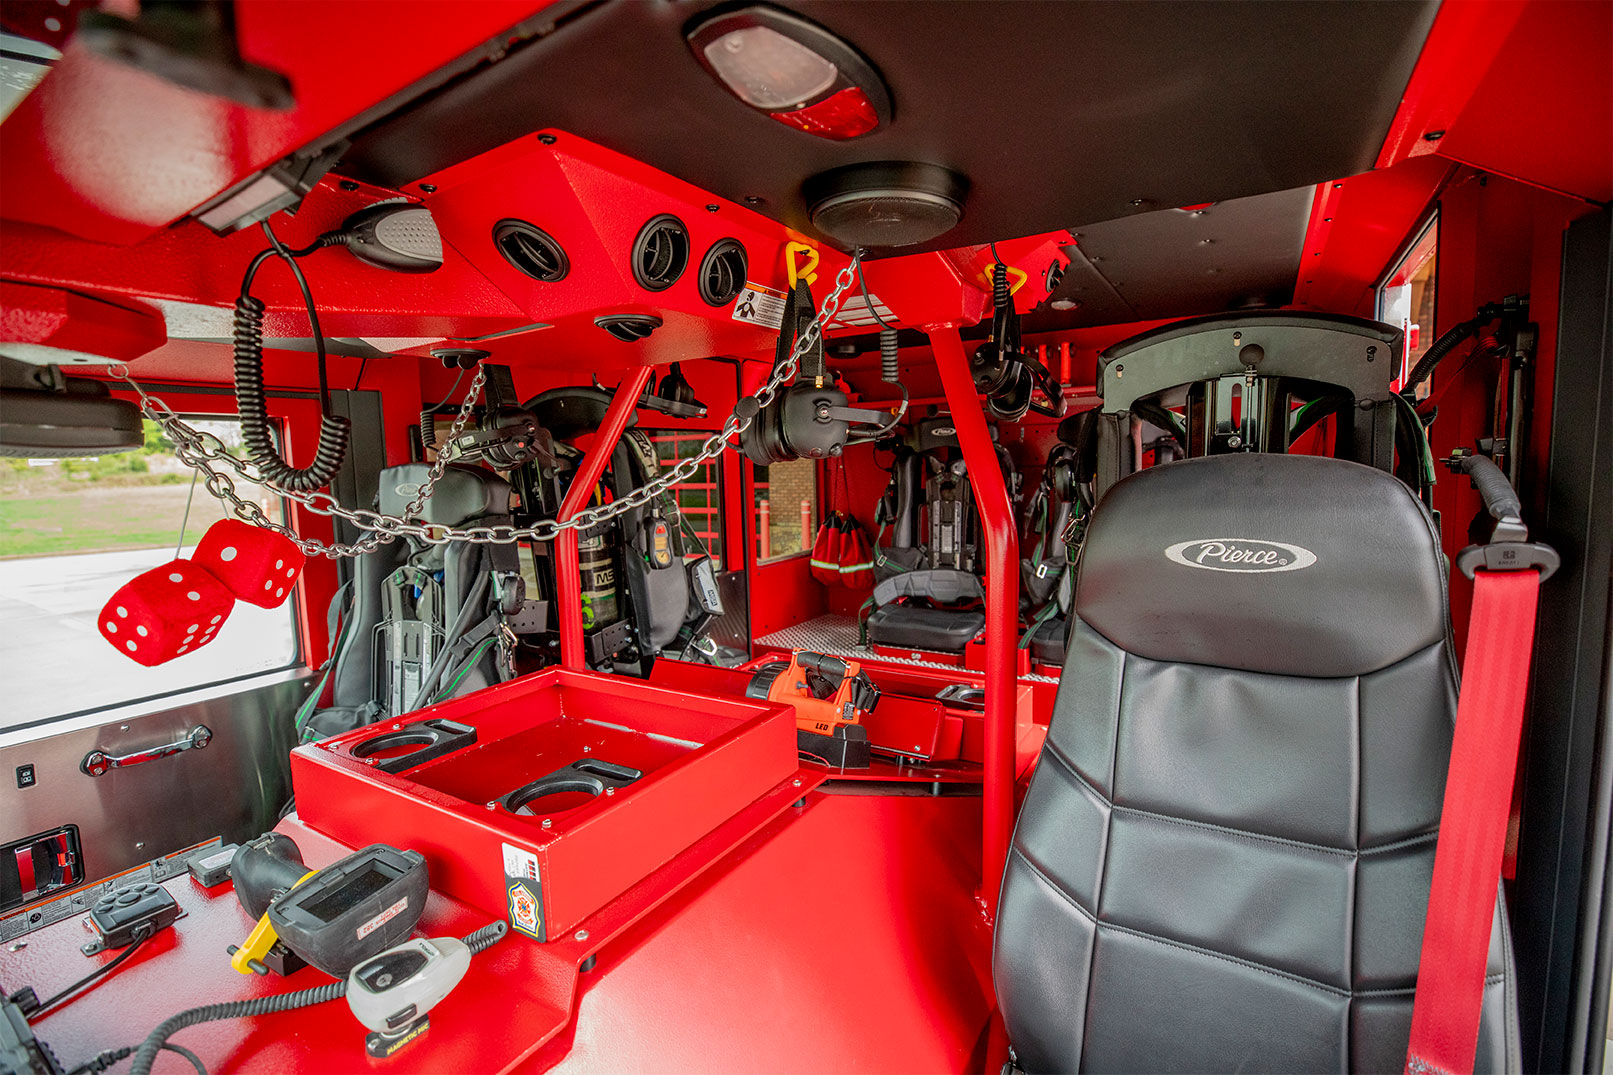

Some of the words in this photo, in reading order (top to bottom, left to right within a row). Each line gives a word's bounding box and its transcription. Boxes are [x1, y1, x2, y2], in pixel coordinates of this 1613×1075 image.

[1195, 542, 1279, 565] Pierce
[596, 570, 614, 584] MS
[815, 722, 829, 731] LED
